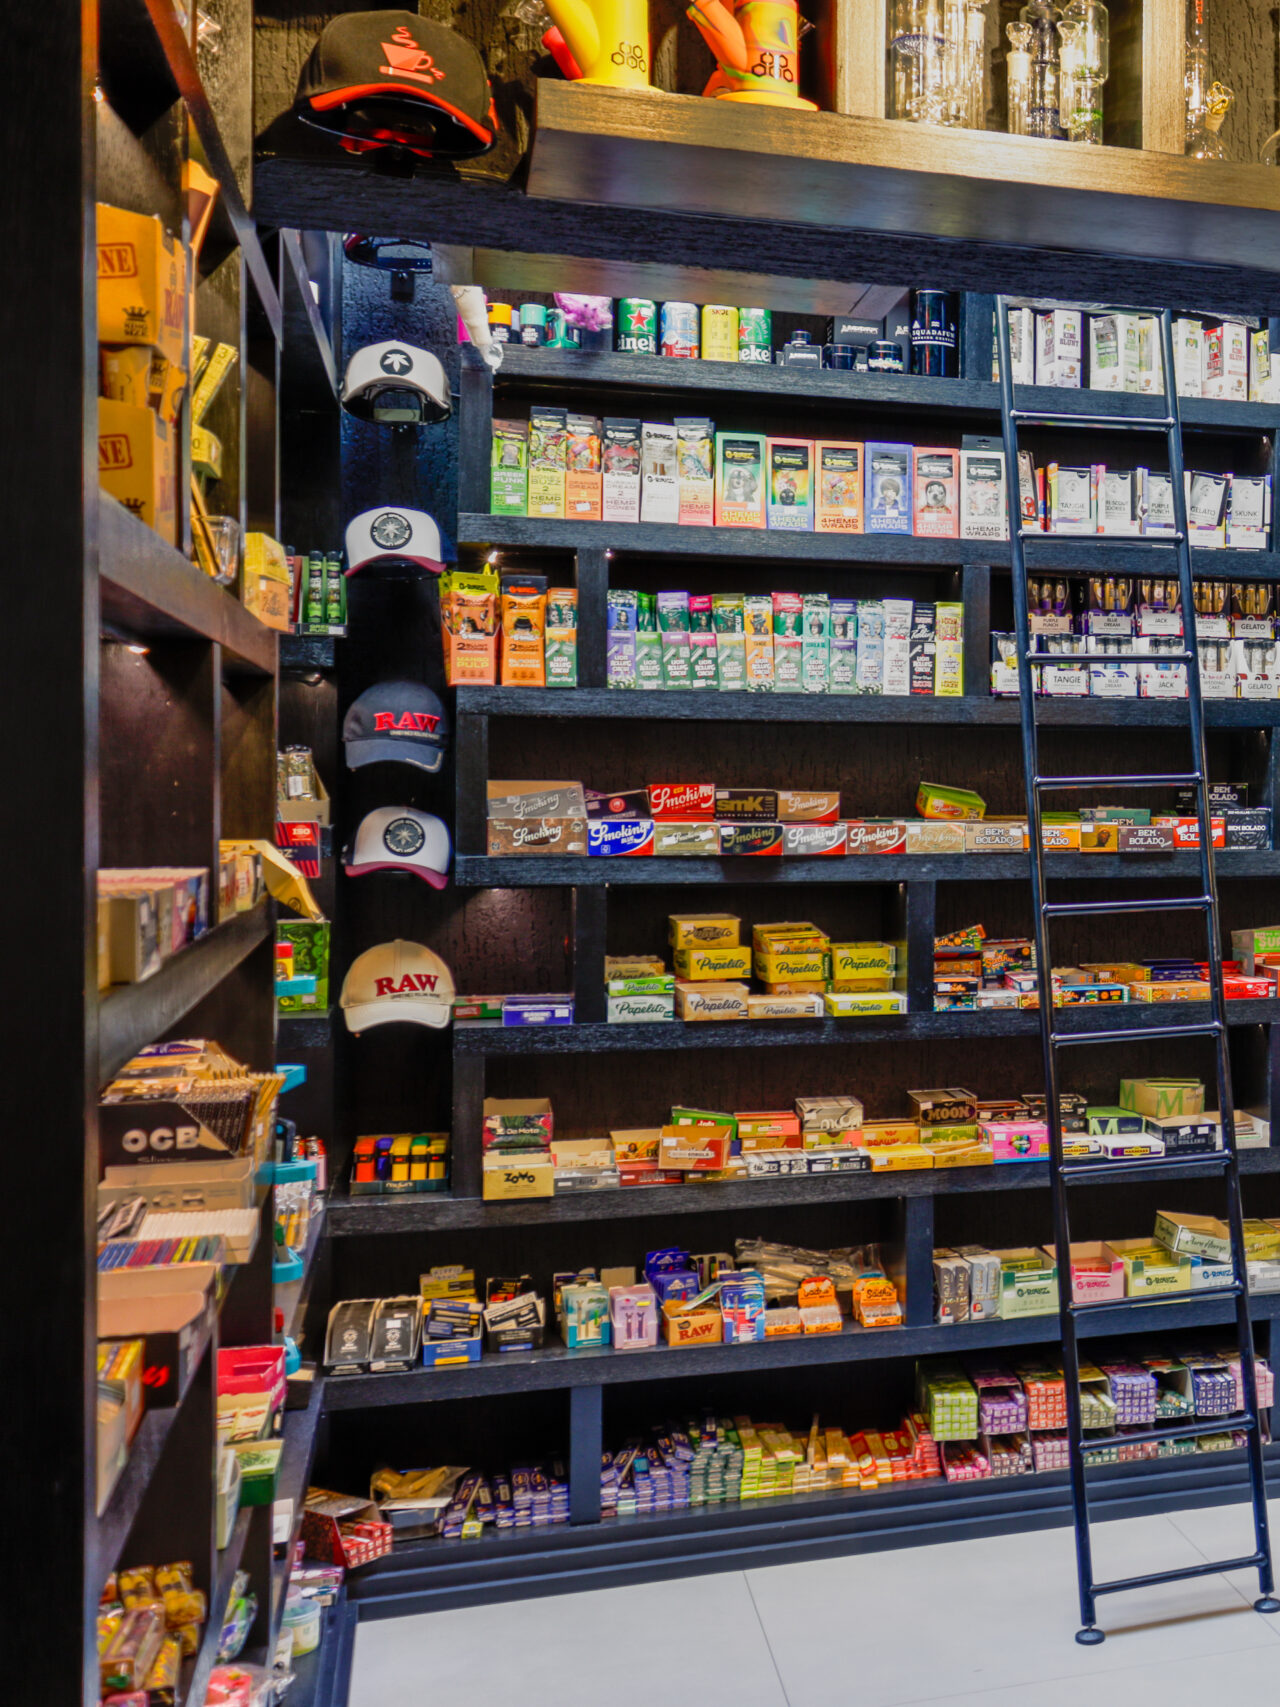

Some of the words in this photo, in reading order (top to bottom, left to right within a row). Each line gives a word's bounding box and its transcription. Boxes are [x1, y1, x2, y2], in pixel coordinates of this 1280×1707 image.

[1053, 675, 1081, 684] TANGIE
[1158, 681, 1174, 689] JACK
[373, 711, 441, 733] RAW
[513, 793, 560, 819] Smoking
[651, 785, 715, 814] Smoking
[787, 793, 829, 813] Smoking
[292, 827, 310, 836] ISO
[513, 824, 563, 846] Smoking
[590, 822, 654, 847] Smoking
[723, 828, 777, 849] Smoking
[787, 824, 839, 849] Smoking
[849, 824, 899, 848] Smoking
[985, 828, 1005, 837] BEM
[1136, 829, 1157, 837] BEM
[975, 836, 1014, 845] BOLADO
[1128, 837, 1165, 846] BOLADO
[697, 957, 746, 972] Papelito
[776, 961, 822, 975] Papelito
[840, 956, 888, 970] Papelito
[373, 973, 440, 998] RAW
[627, 980, 660, 992] Papelito
[615, 1002, 667, 1015] Papelito
[691, 999, 743, 1013] Papelito
[763, 1005, 798, 1016] Papelito
[850, 1003, 883, 1013] Papelito
[927, 1105, 970, 1121] MOON
[121, 1126, 201, 1153] OCB
[678, 1322, 716, 1341] RAW
